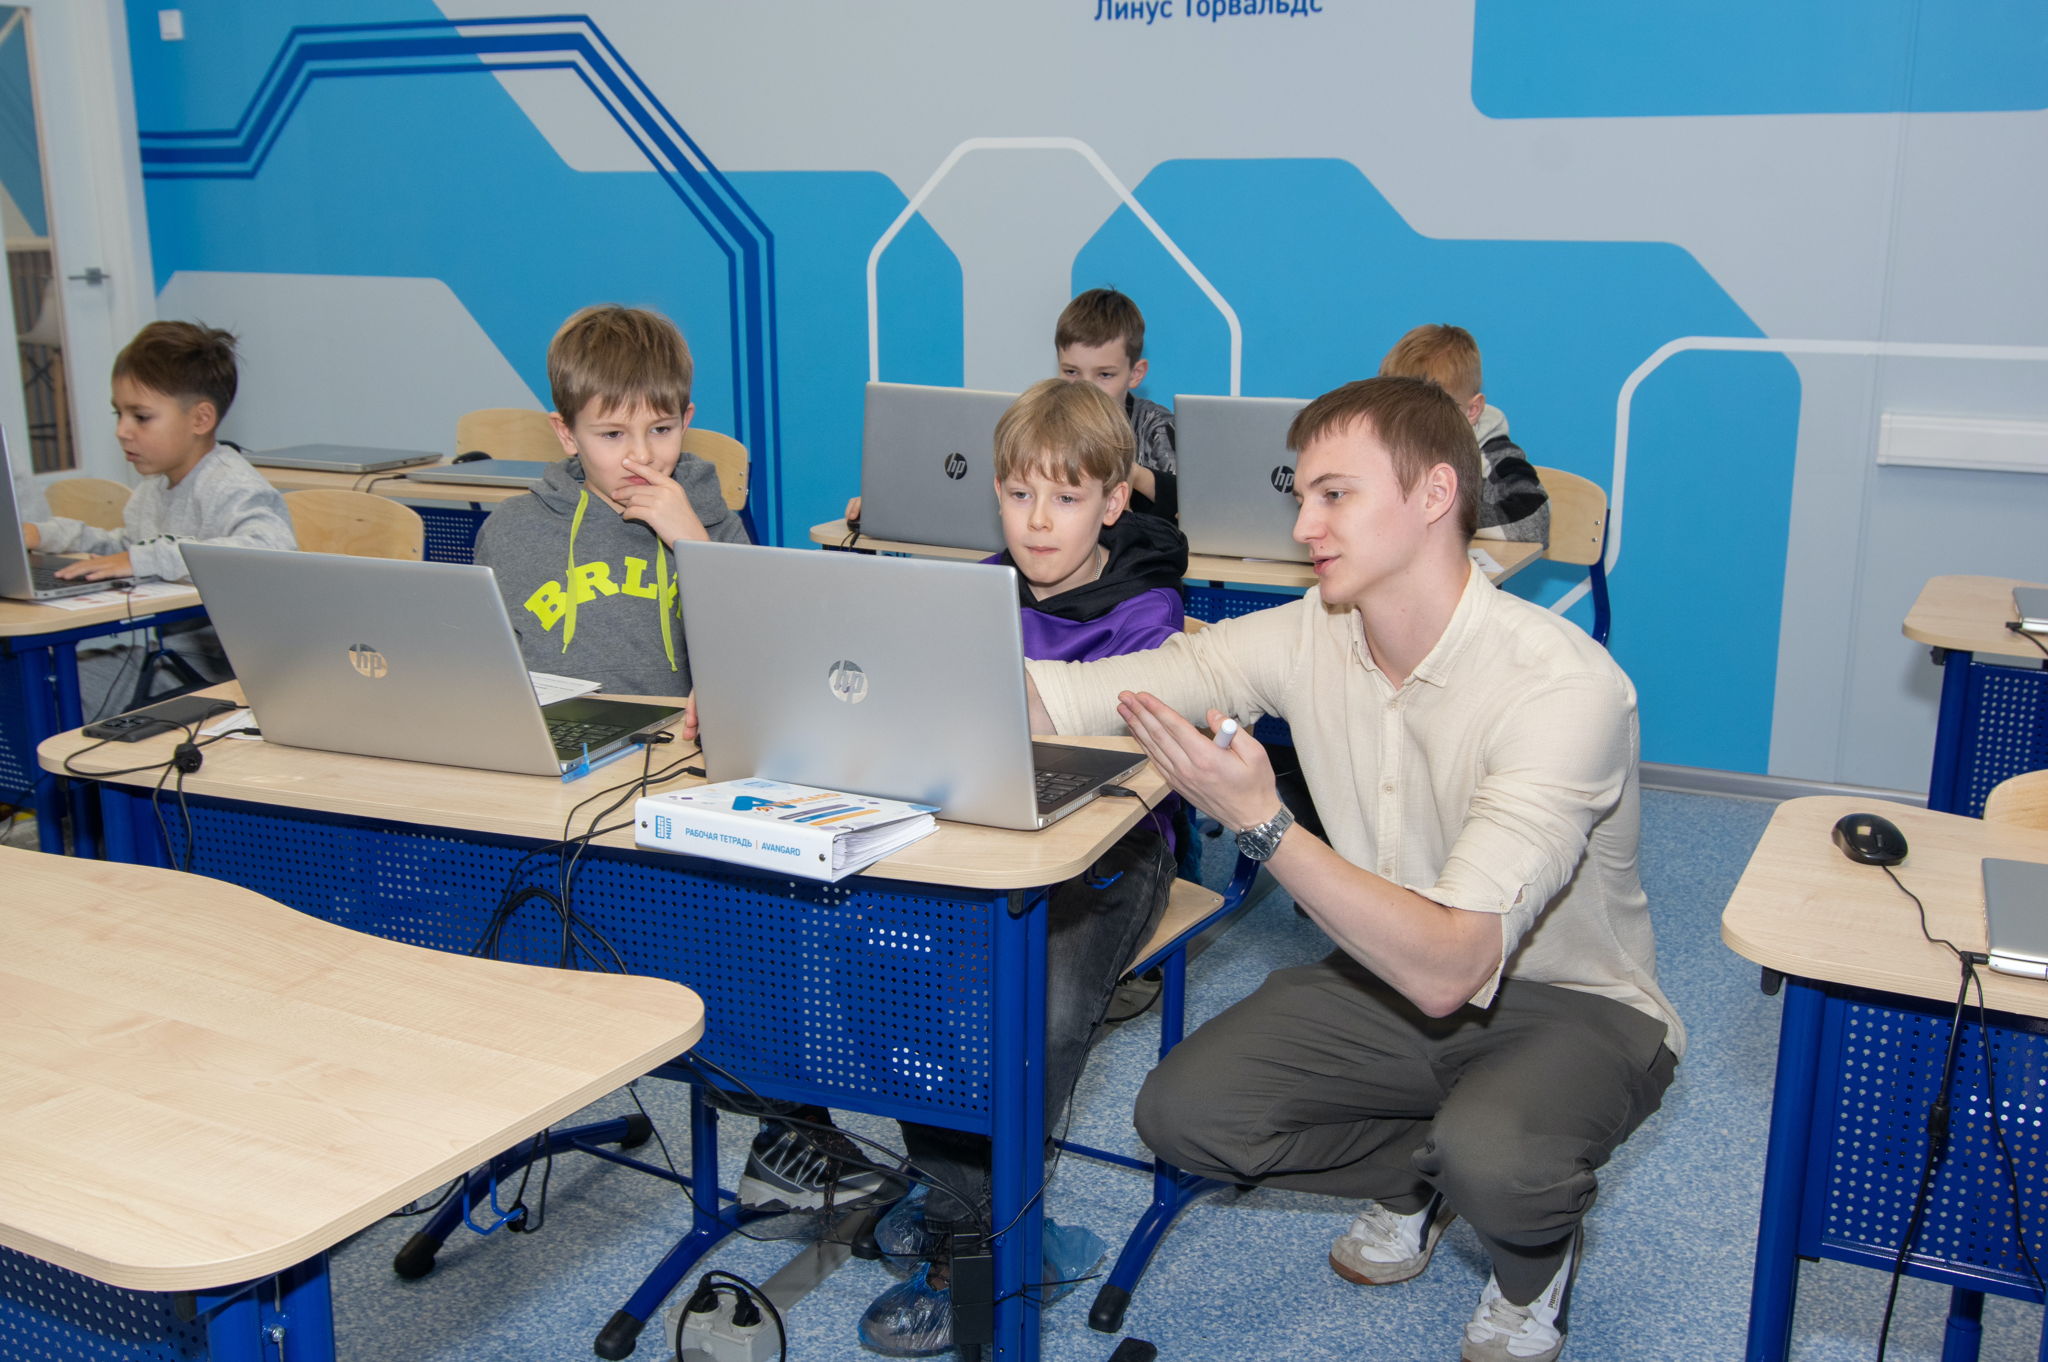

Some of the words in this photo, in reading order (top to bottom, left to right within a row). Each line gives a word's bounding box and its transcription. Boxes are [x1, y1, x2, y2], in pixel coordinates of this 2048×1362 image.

[1094, 0, 1173, 25] Линус
[945, 453, 967, 480] hp
[523, 556, 681, 631] BRL
[352, 643, 386, 679] hp
[831, 660, 867, 704] hp
[685, 827, 718, 841] РАБОЧАЯ
[720, 834, 753, 848] ТЕТРАДЬ
[761, 842, 801, 856] AVANGARD
